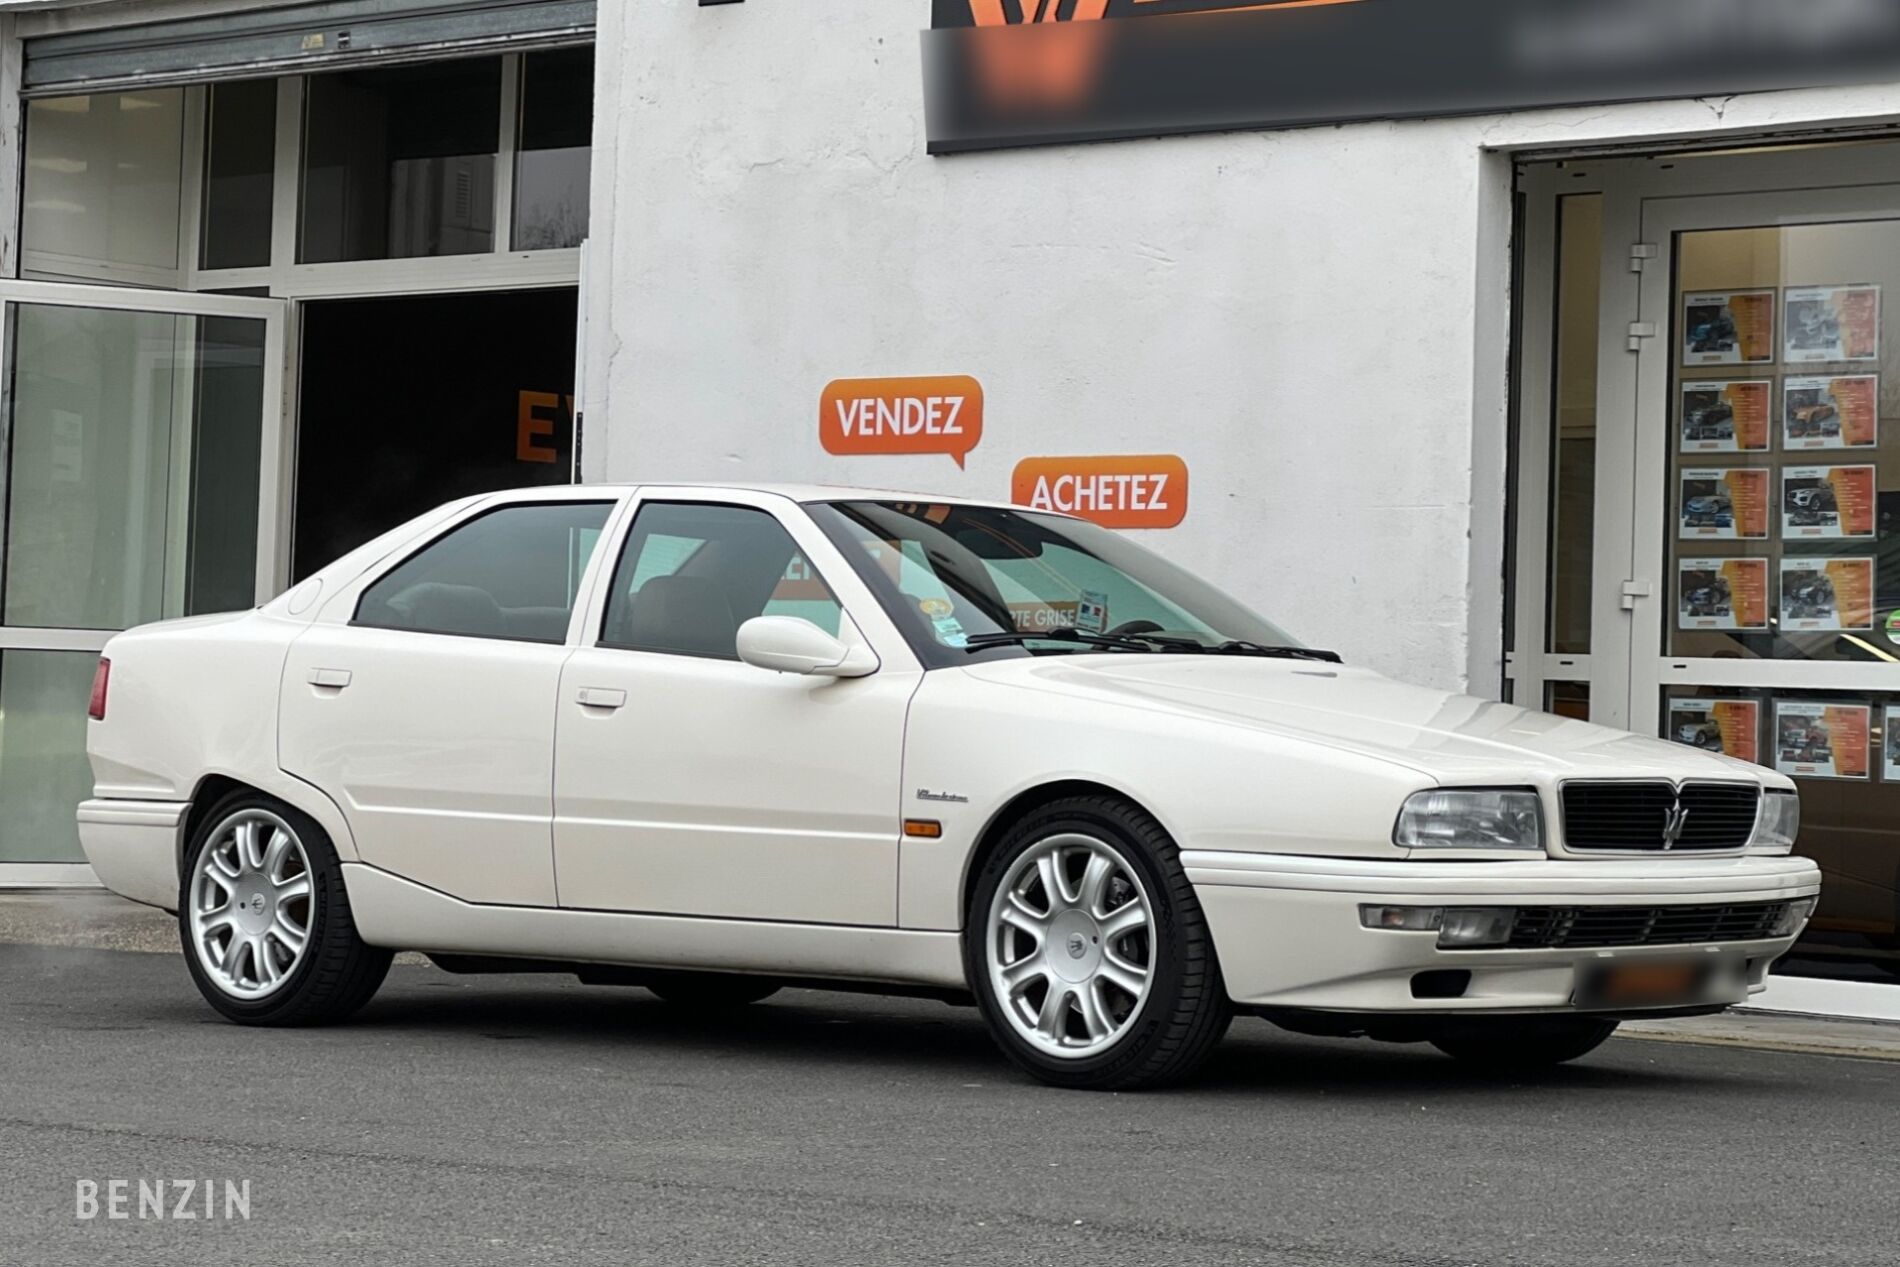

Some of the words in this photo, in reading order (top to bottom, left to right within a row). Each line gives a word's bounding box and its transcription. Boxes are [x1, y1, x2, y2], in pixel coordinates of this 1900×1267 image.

[835, 396, 965, 437] VENDEZ
[1029, 473, 1169, 512] ACHETEZ
[1034, 608, 1076, 628] GRISE
